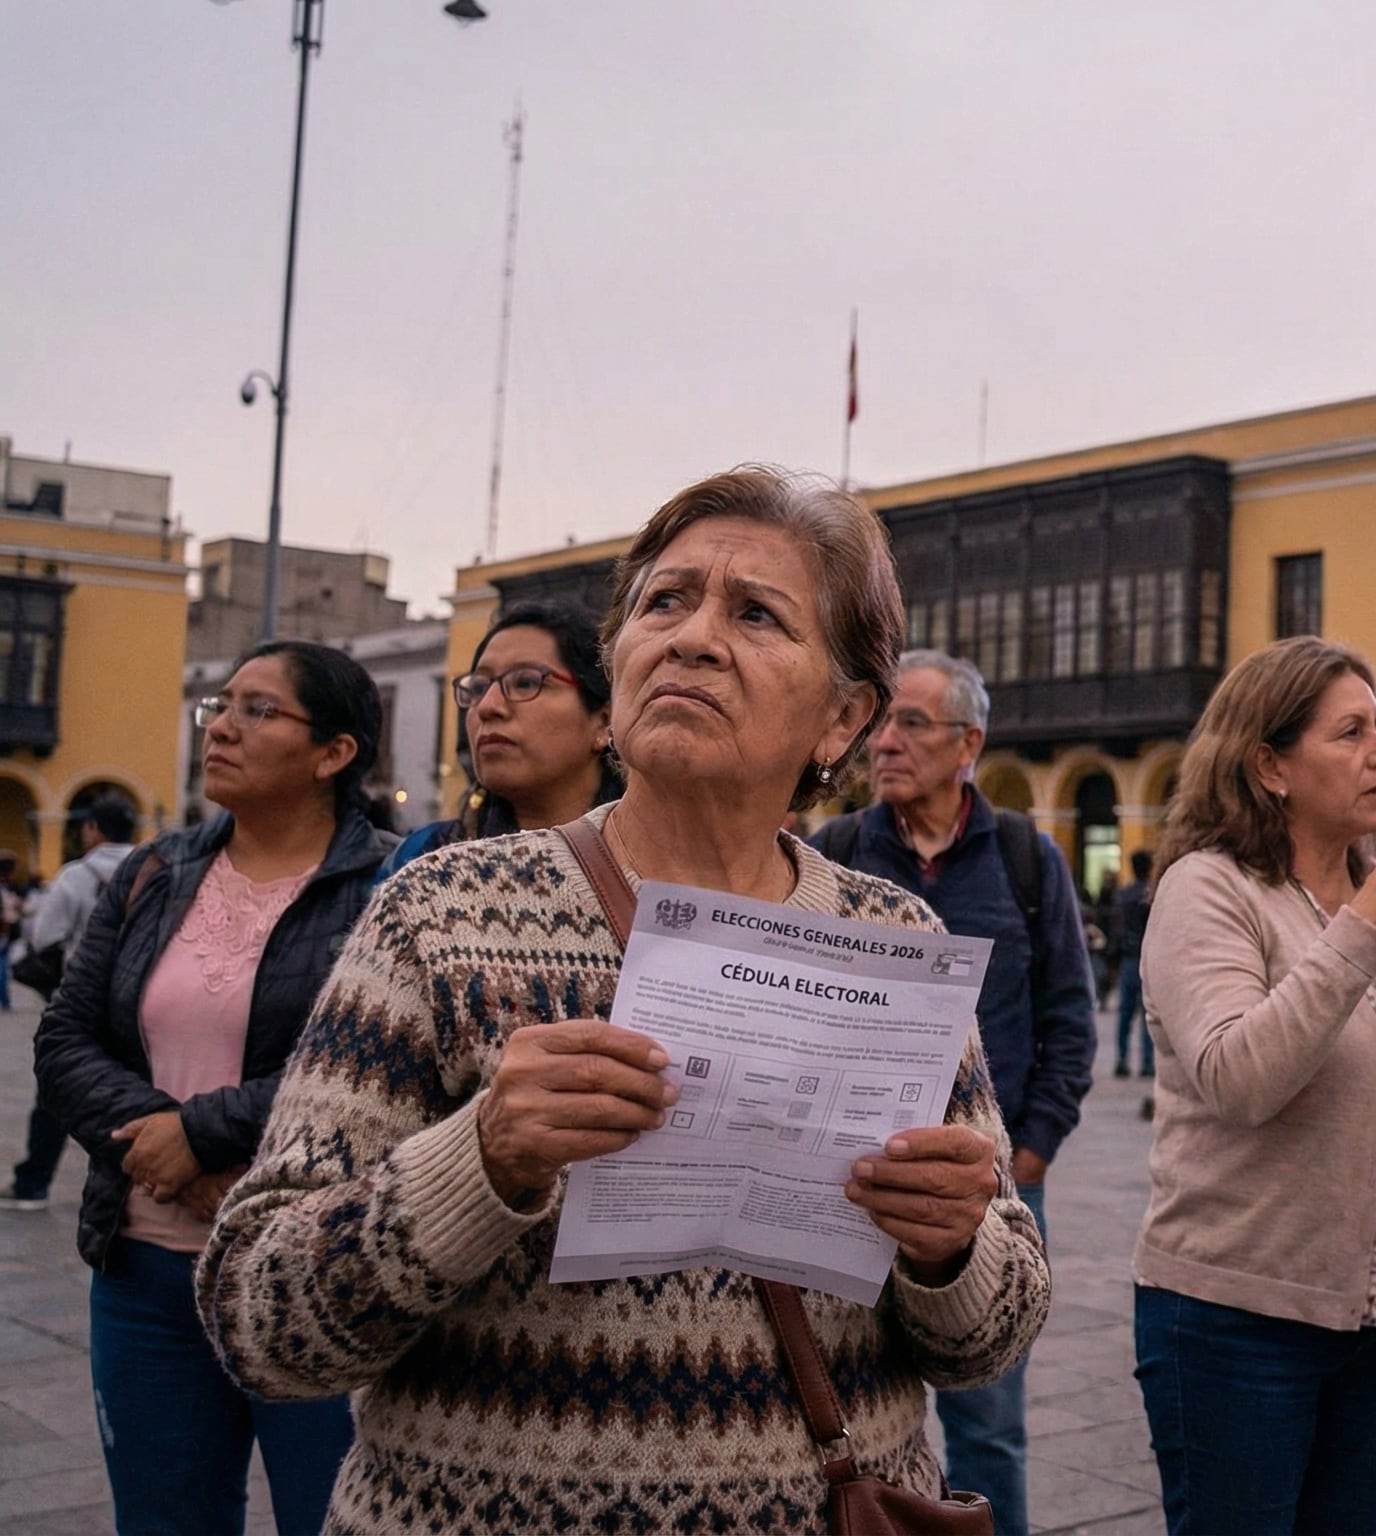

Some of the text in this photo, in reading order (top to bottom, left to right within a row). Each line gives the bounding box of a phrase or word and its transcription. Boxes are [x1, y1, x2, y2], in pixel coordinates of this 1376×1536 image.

[711, 909, 801, 939] ELECCIONES
[803, 928, 888, 956] GENERALES
[889, 944, 925, 960] 2026
[720, 963, 890, 1007] CÉDULA ELECTORAL
